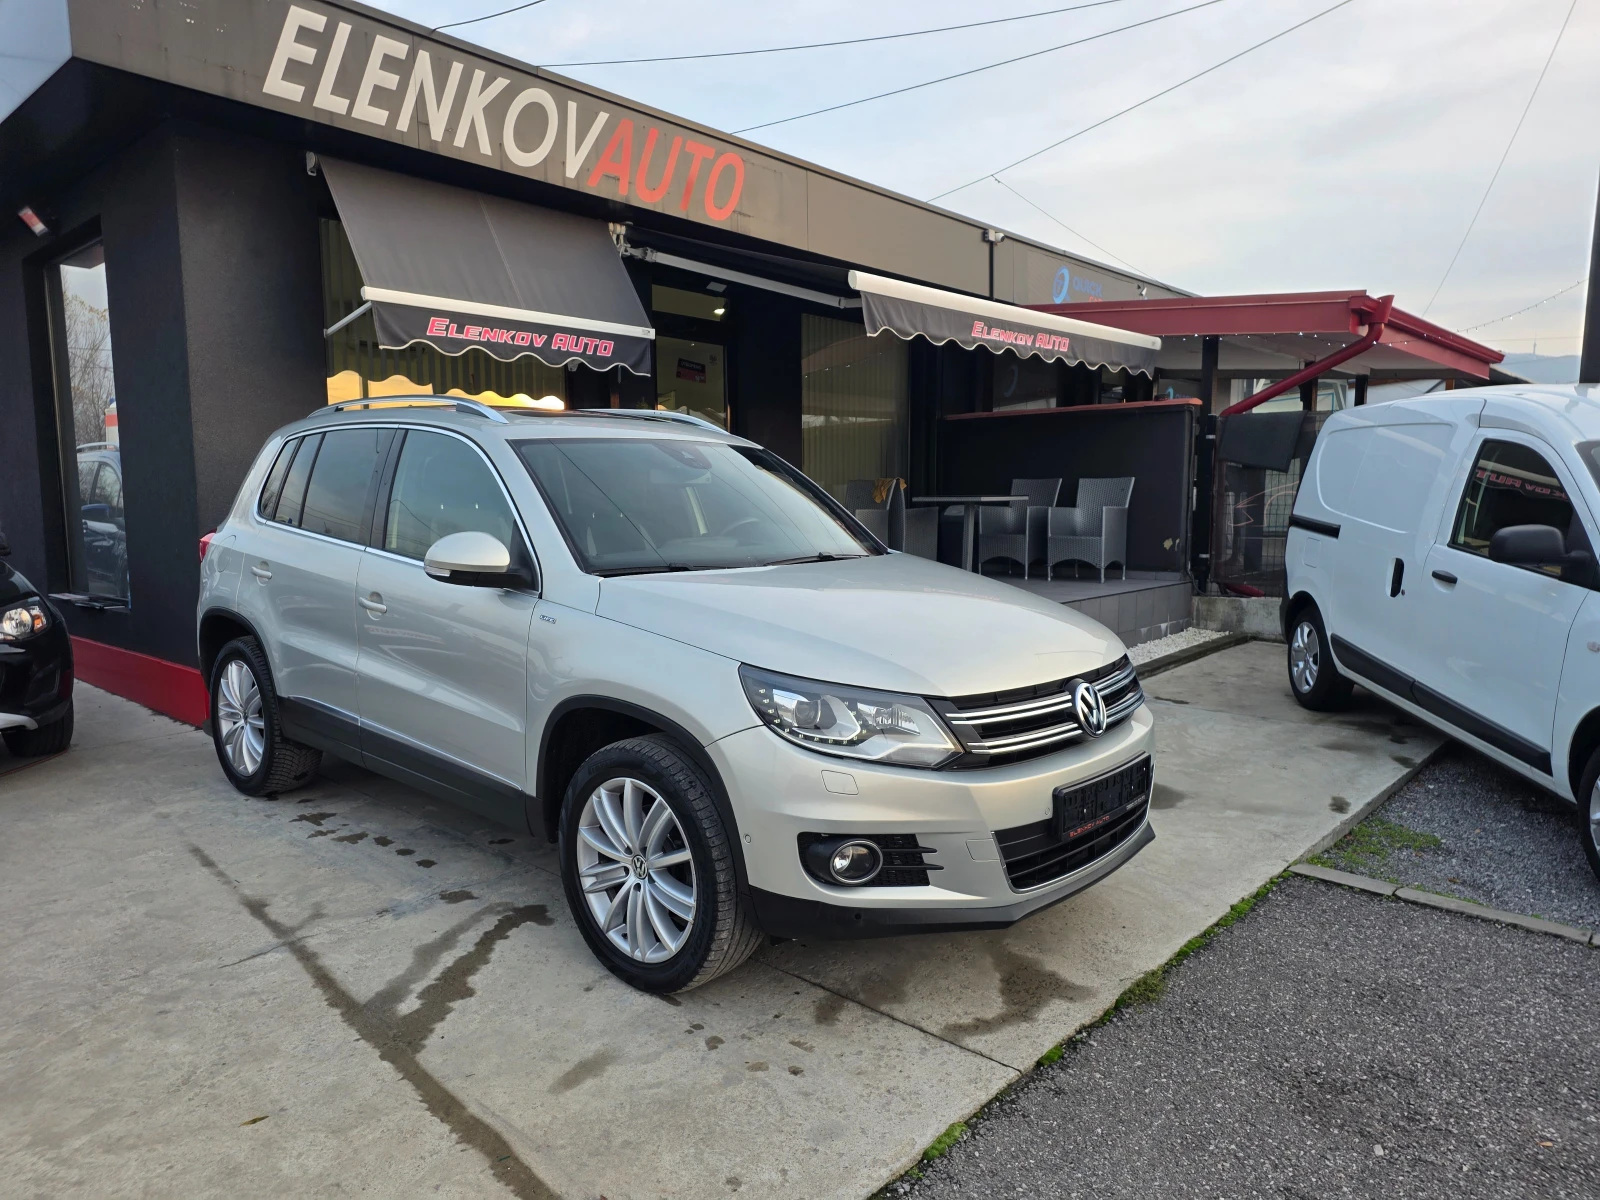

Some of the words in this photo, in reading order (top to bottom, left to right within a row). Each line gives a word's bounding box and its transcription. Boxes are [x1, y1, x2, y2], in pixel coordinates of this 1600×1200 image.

[1072, 276, 1103, 298] QUICK
[426, 317, 547, 348] ELENKOV
[551, 333, 614, 357] AUTO
[971, 321, 1035, 346] ELENKOV
[1035, 333, 1070, 352] AUTO
